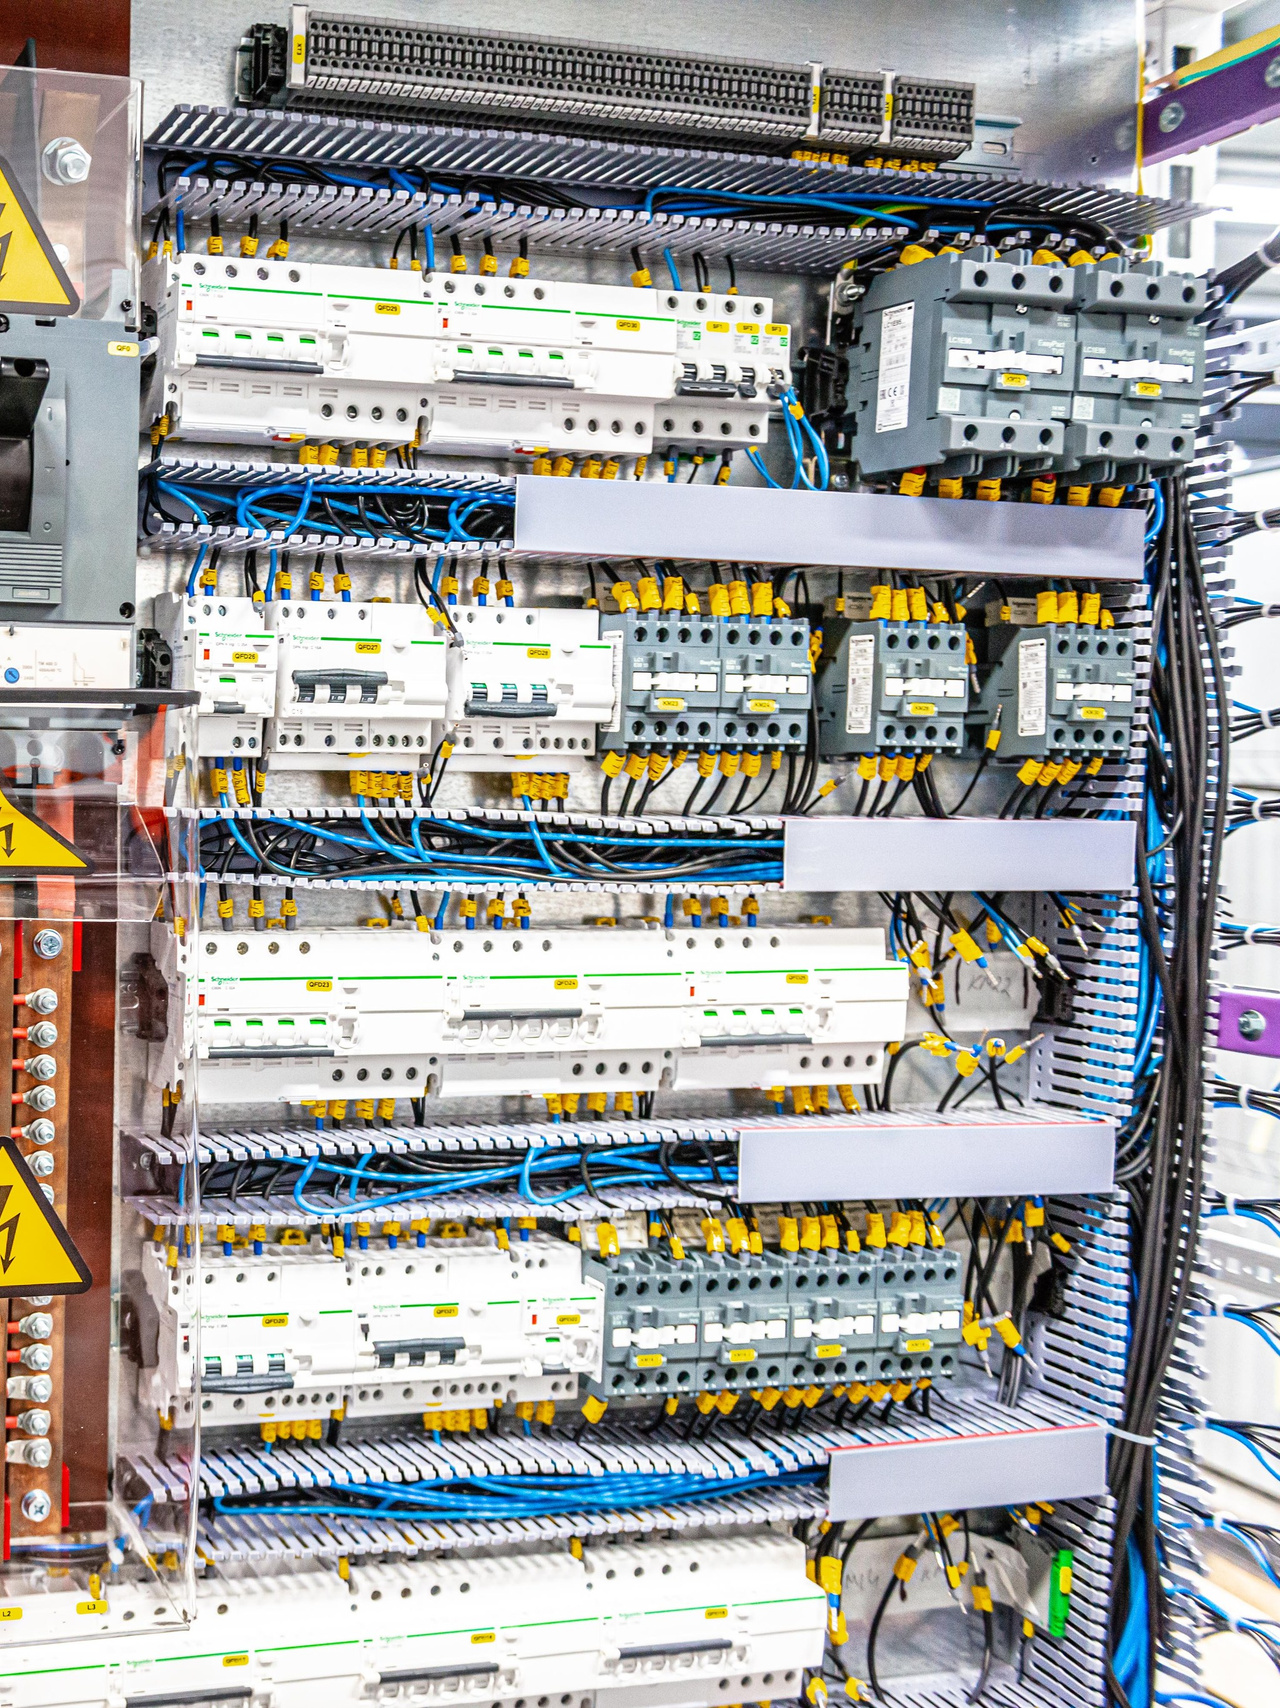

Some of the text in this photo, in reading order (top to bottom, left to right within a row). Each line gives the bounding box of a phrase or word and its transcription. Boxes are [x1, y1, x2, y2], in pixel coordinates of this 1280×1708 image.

[214, 631, 242, 641] Schneider
[357, 643, 379, 651] QFD27
[210, 976, 239, 986] Schneider
